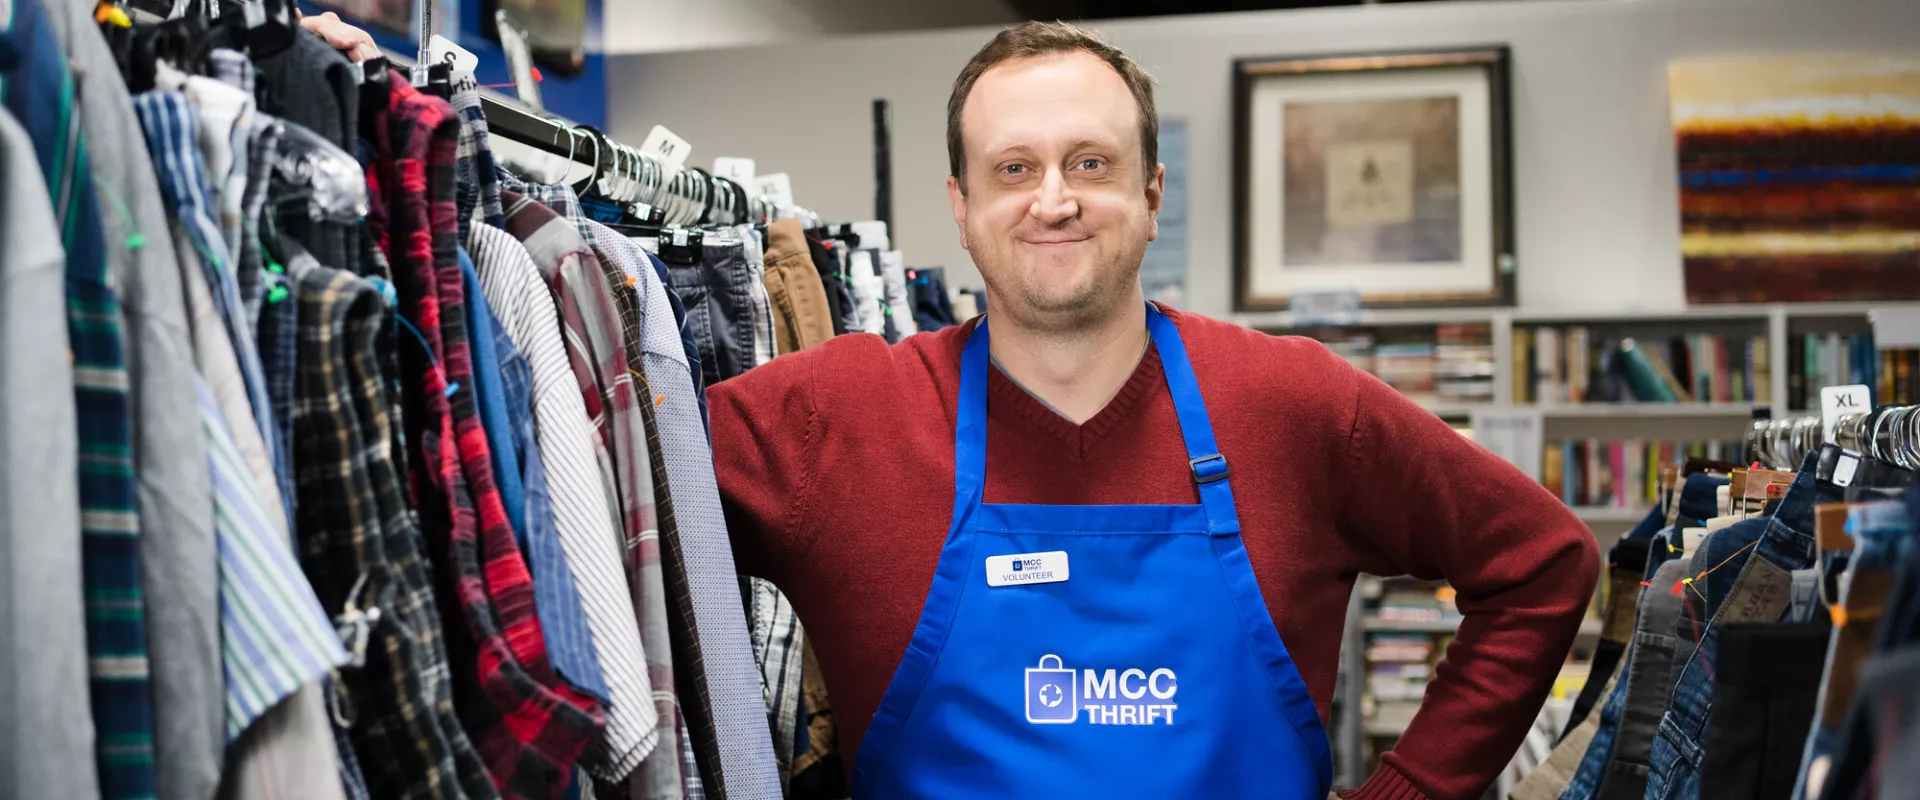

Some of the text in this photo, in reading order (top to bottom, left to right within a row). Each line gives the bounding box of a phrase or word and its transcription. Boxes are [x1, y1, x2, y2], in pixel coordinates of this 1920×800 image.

[441, 51, 456, 71] S
[659, 139, 675, 156] M
[730, 165, 740, 177] L
[1834, 393, 1860, 408] XL
[1003, 571, 1053, 581] VOLUNTEER
[1084, 667, 1177, 699] MCC
[1084, 704, 1178, 725] THRIFT
